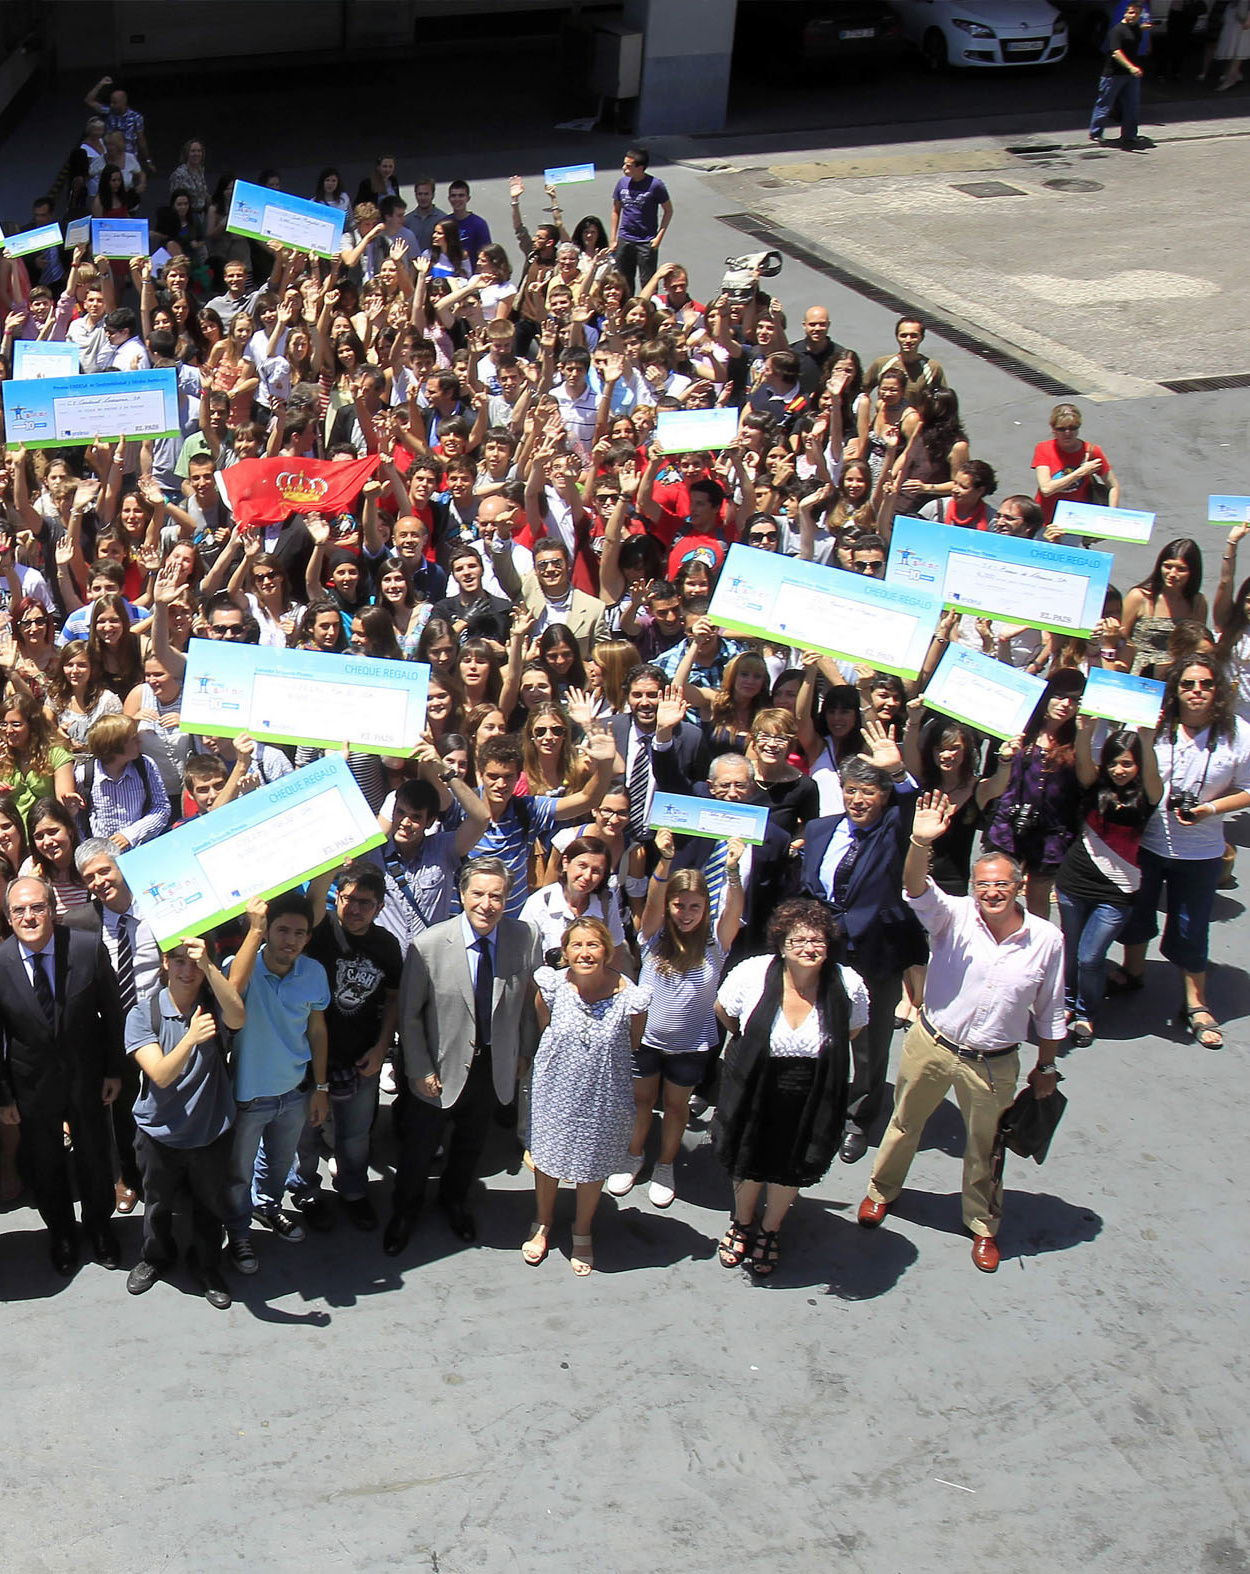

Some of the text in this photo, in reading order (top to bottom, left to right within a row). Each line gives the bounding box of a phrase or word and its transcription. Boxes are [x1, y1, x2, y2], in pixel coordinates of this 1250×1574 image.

[1030, 549, 1100, 569] CHEQUE REGALO
[864, 585, 932, 610] CHEQUE REGALO
[344, 664, 418, 680] CHEQUE REGALO
[268, 764, 338, 803] CHEQUE REGALO
[347, 968, 375, 987] CASH
